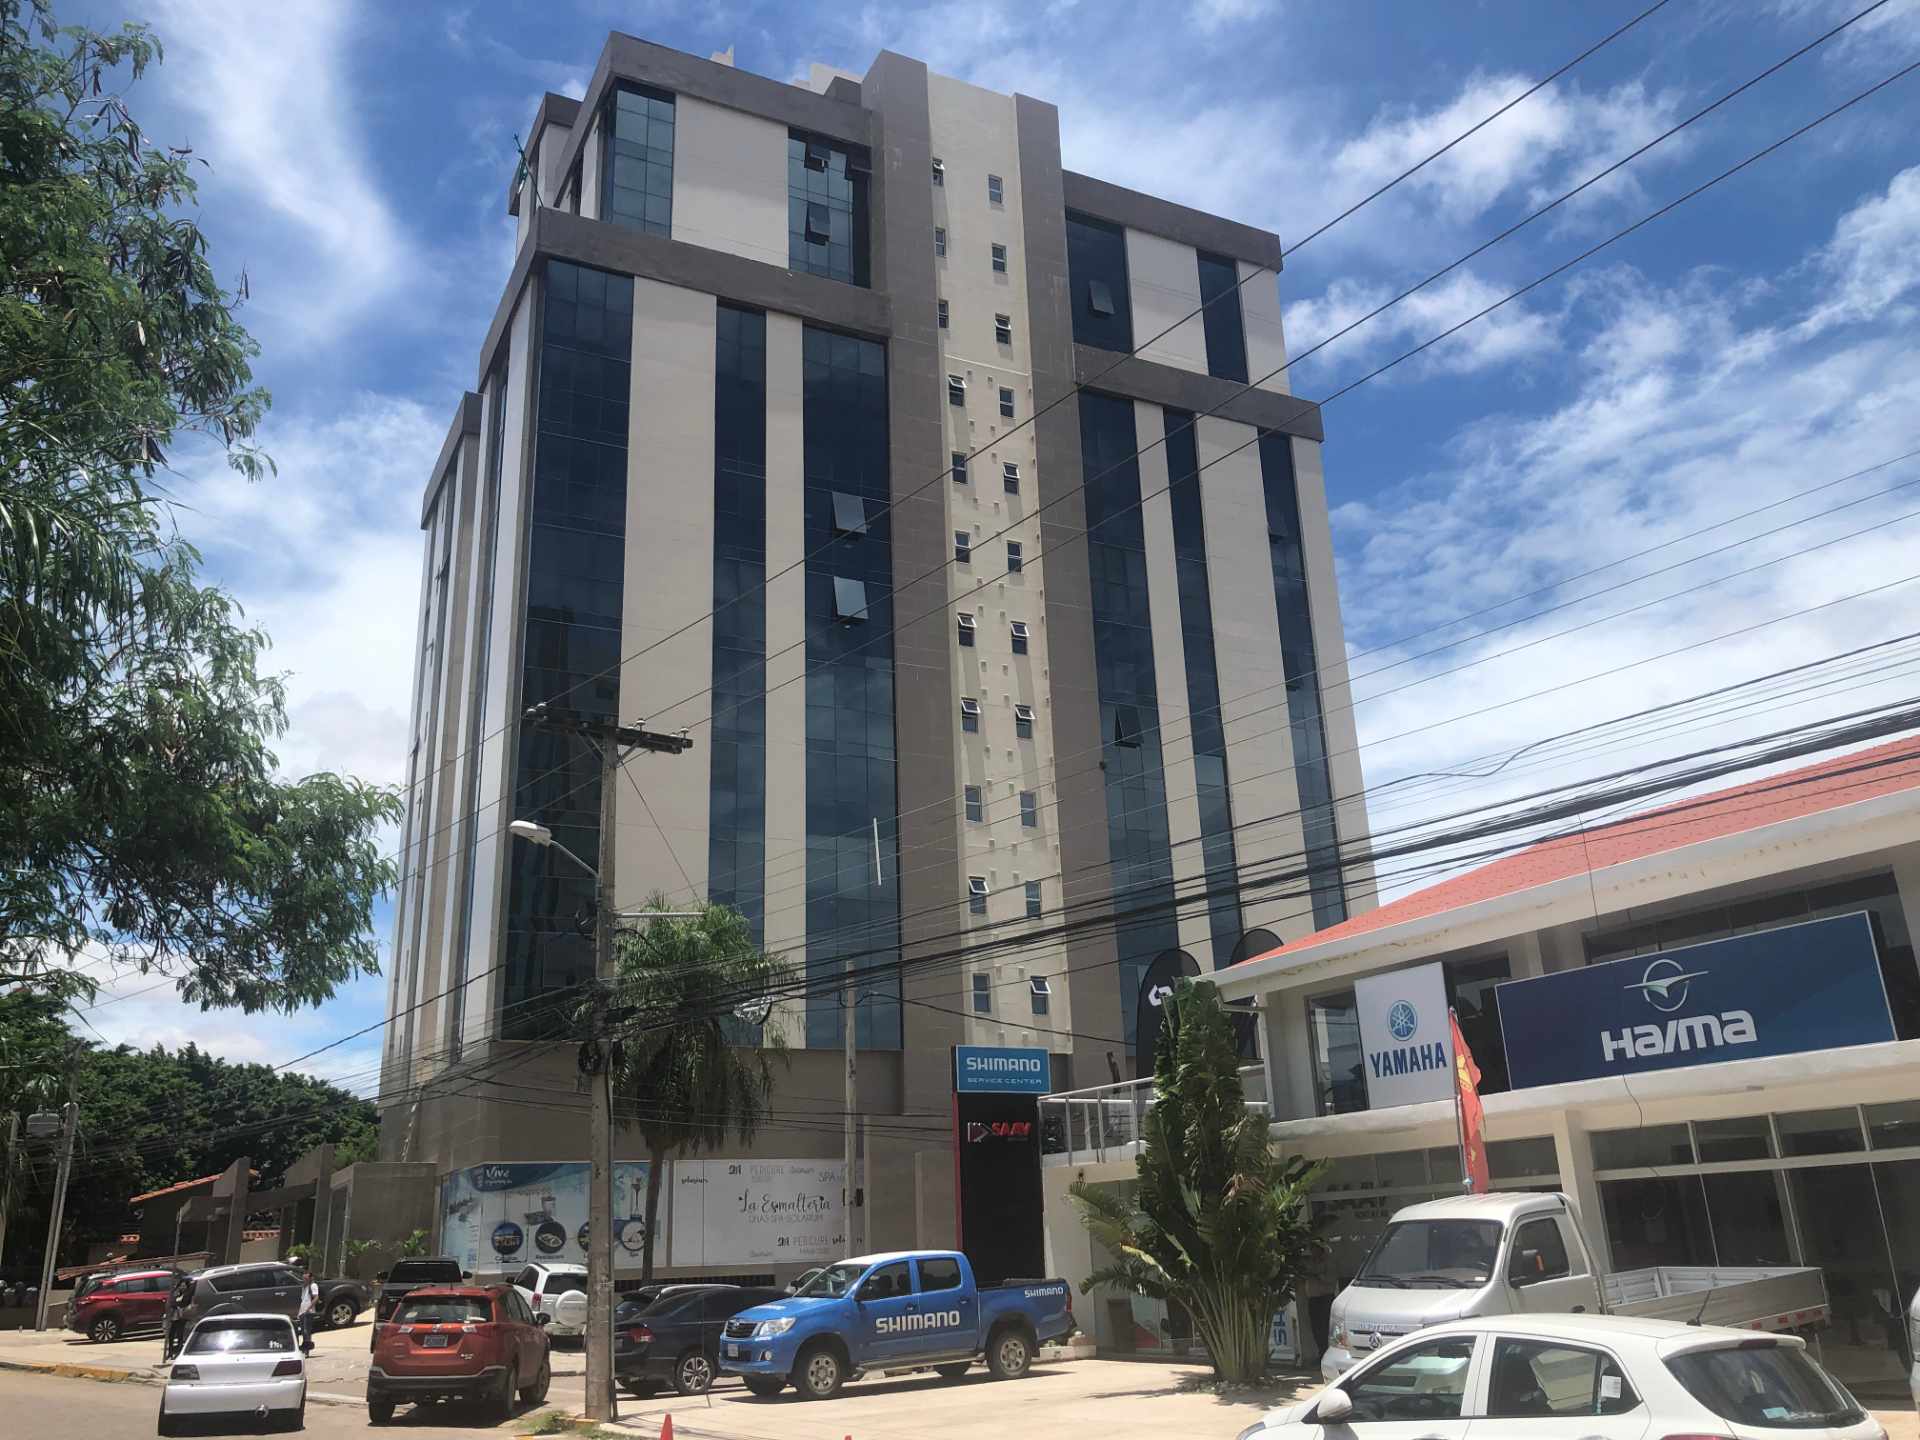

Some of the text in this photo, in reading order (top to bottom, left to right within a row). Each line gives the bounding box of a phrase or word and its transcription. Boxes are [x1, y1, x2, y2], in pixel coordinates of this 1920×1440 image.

[966, 1057, 1041, 1072] SHIMANO
[1370, 1042, 1447, 1078] YAMAHA
[1024, 1286, 1064, 1298] SHIMANO
[875, 1310, 960, 1333] SHIMANO
